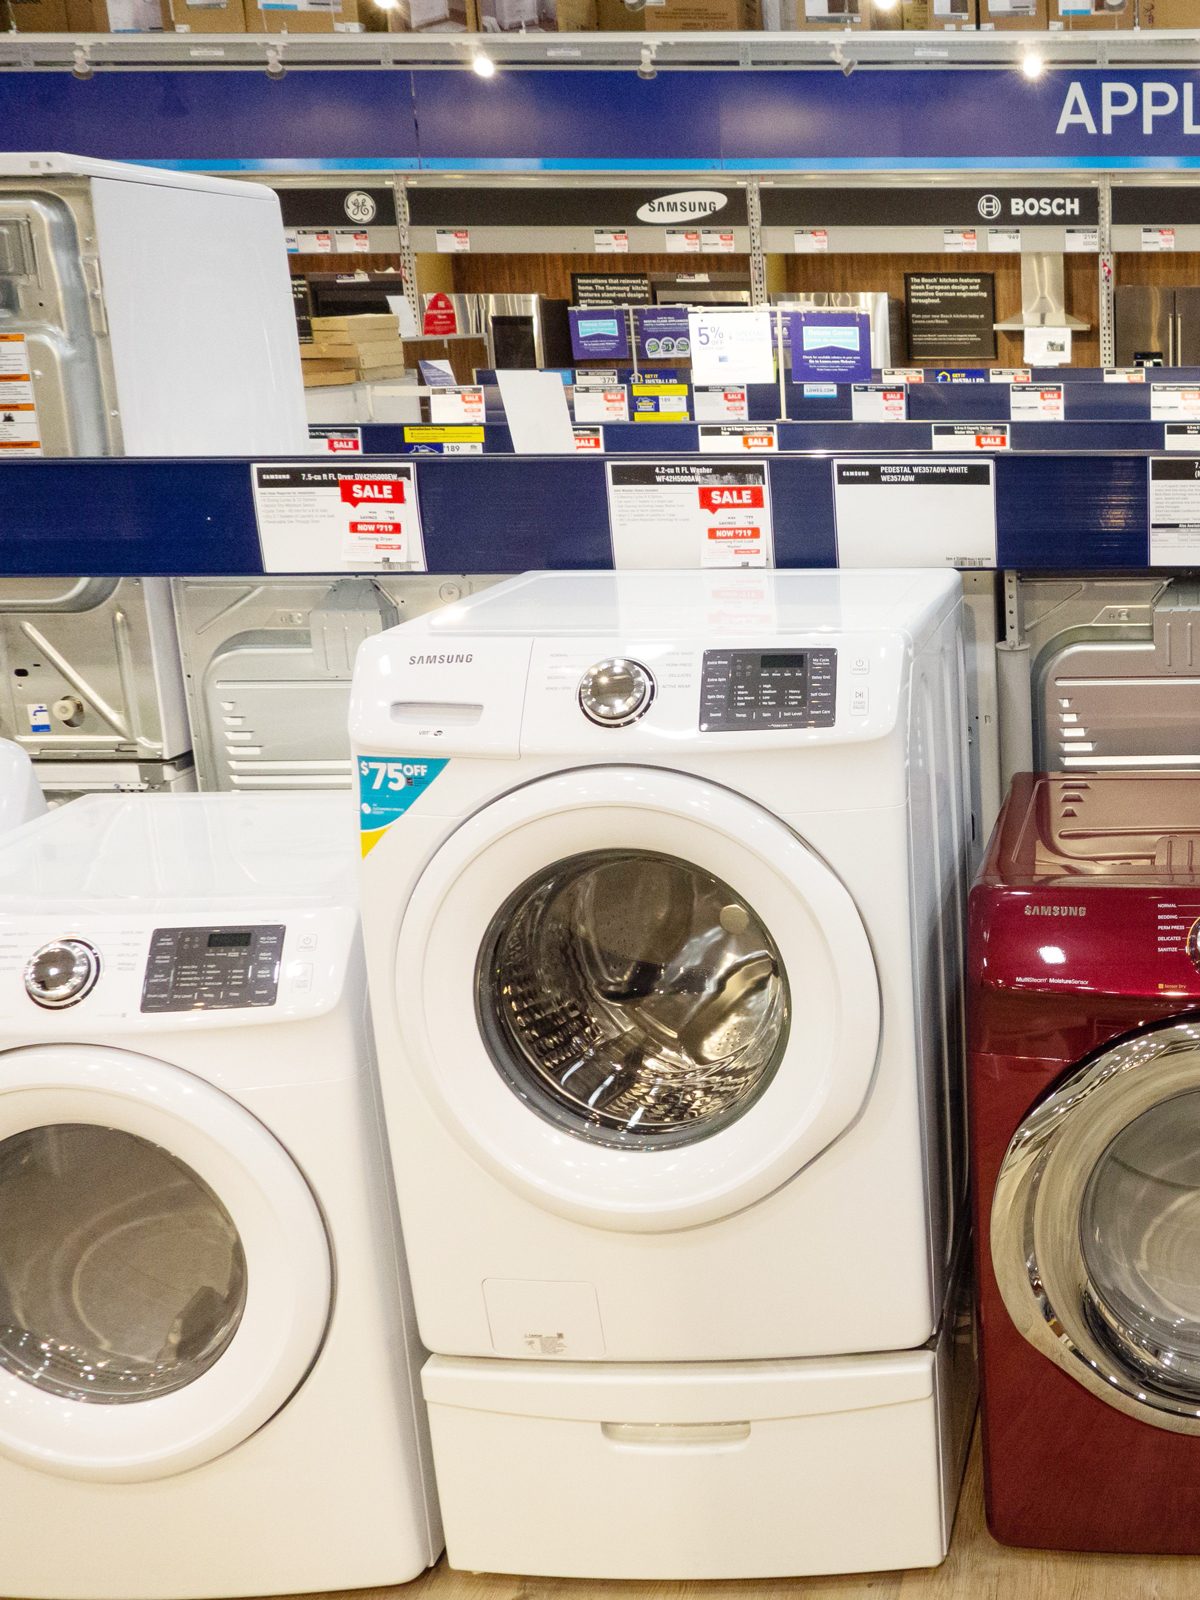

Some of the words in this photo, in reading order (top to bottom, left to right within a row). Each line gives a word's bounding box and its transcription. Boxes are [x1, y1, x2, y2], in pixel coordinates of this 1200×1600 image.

[648, 200, 717, 213] SAMSUNG
[1010, 197, 1080, 216] BOSCH
[886, 392, 901, 400] SALE
[333, 441, 354, 449] SALE
[748, 438, 768, 446] SALE
[980, 437, 1001, 445] SALE
[655, 466, 674, 474] 4.2-cu
[690, 466, 713, 474] Washer
[352, 484, 393, 499] SALE
[711, 490, 752, 504] SALE
[408, 653, 474, 665] SAMSUNG
[360, 761, 406, 791] $75
[402, 764, 428, 777] OFF
[1024, 905, 1087, 916] SAMSUNG
